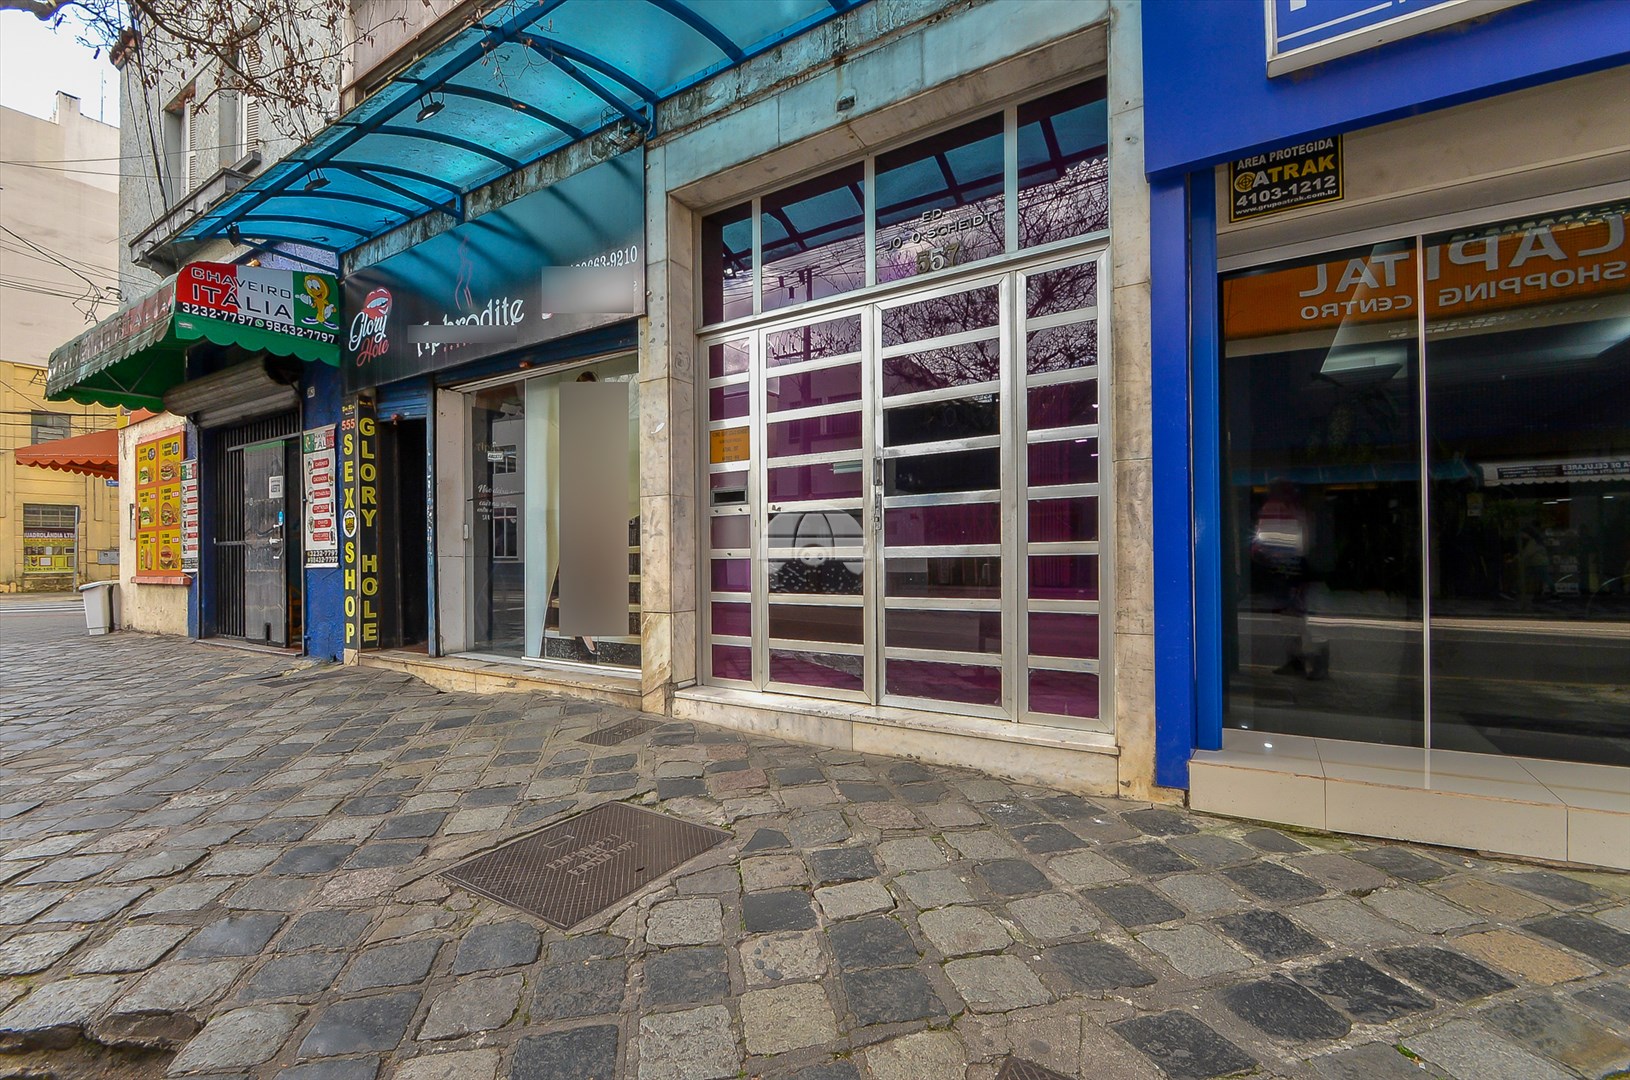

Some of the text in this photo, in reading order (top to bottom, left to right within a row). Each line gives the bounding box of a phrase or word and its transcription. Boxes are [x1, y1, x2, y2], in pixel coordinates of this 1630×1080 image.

[1269, 138, 1334, 162] PROTEGIDA
[1235, 189, 1337, 215] www.grupoatrak.com.br
[1236, 175, 1337, 207] 4103-1212
[927, 212, 994, 238] SCHEIDT
[917, 243, 960, 272] 557
[192, 267, 291, 299] CHAVEIRO
[192, 283, 292, 320] ITÁLIA
[348, 311, 388, 351] Glory
[356, 337, 390, 367] Hole
[341, 418, 356, 431] 555
[343, 433, 355, 509] SEX
[360, 417, 377, 527] GLORY
[344, 541, 356, 643] SHOP
[362, 554, 378, 641] HOLE
